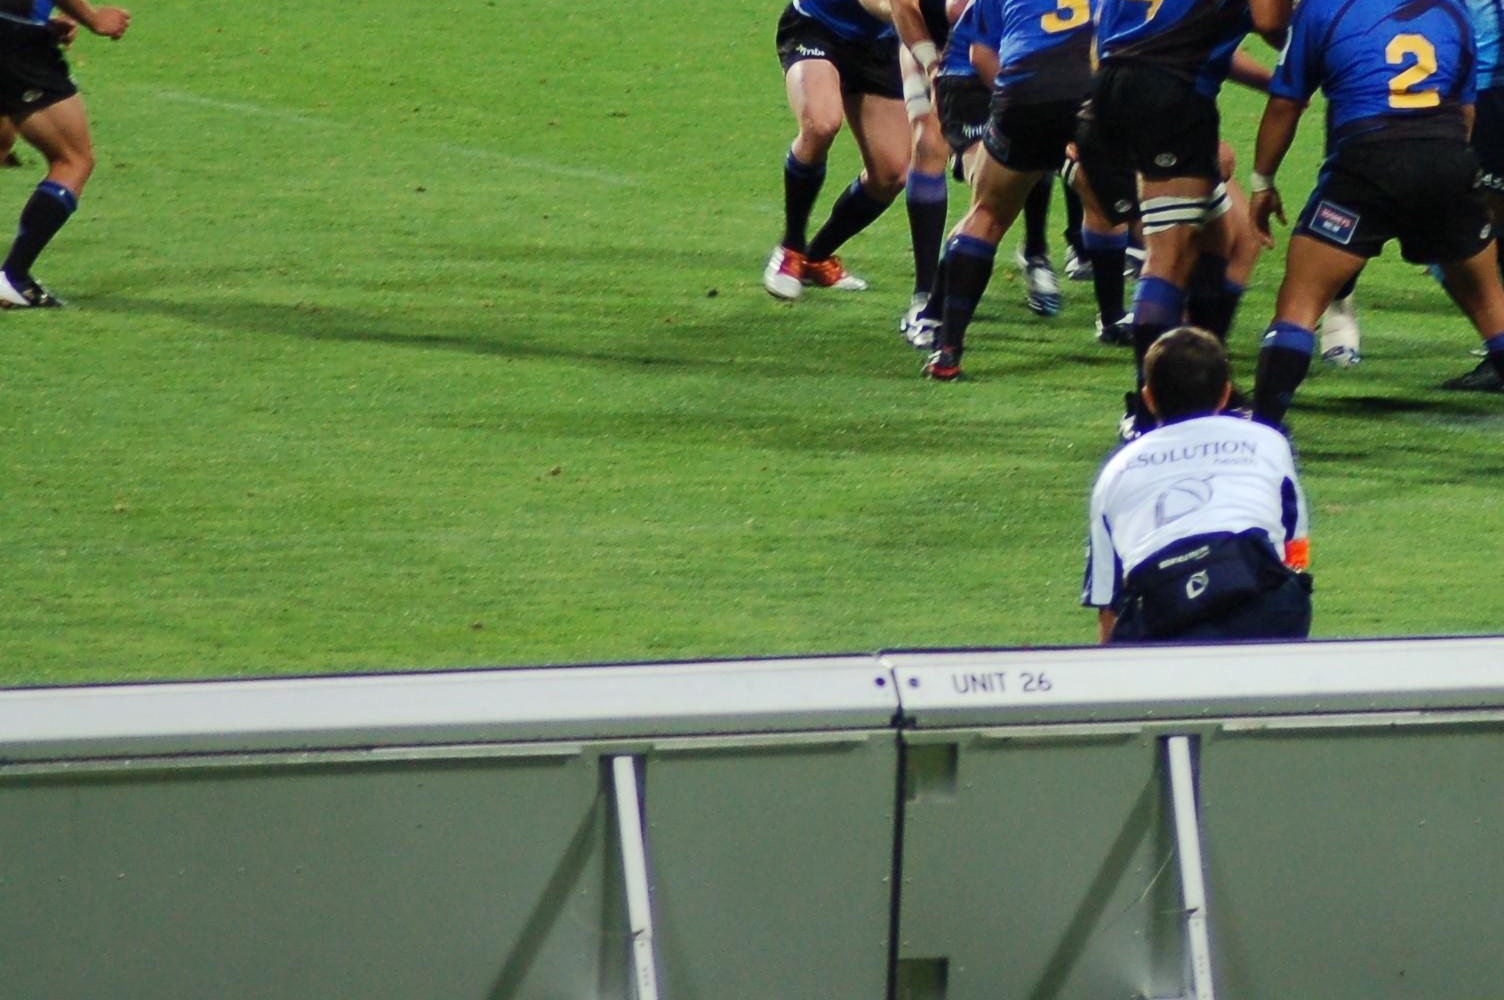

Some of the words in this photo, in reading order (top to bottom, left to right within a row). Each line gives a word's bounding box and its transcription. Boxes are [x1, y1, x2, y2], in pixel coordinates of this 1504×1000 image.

[1385, 33, 1440, 109] 2
[951, 672, 1007, 694] UNIT
[1019, 672, 1052, 692] 26
